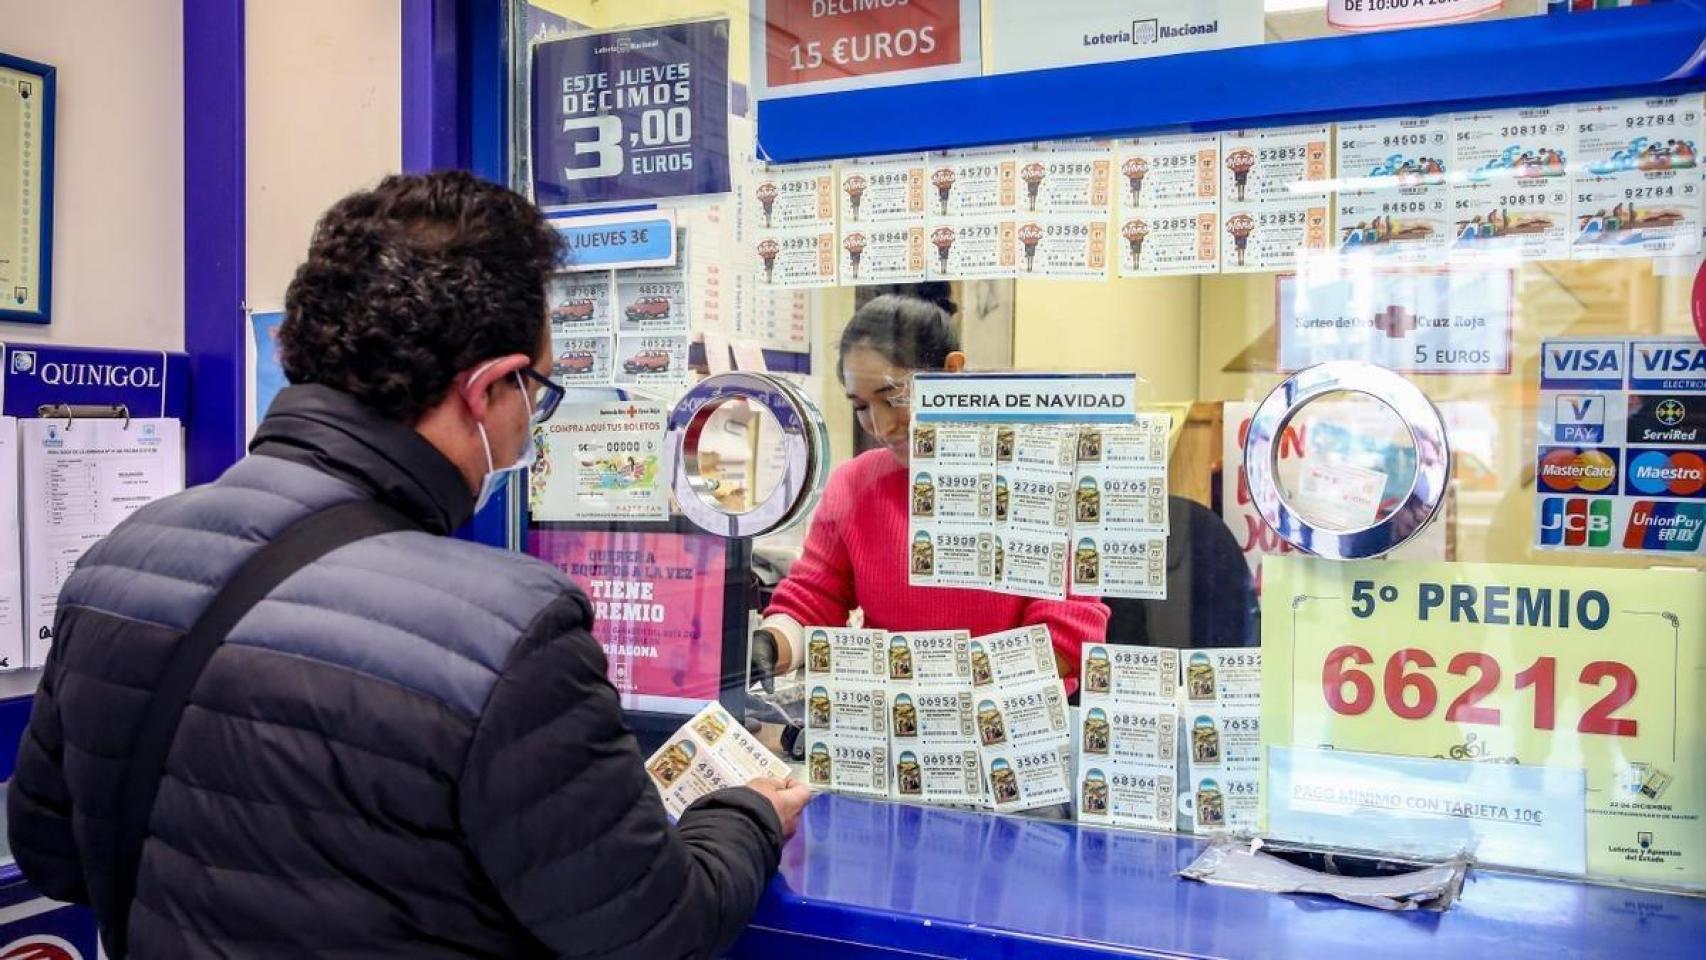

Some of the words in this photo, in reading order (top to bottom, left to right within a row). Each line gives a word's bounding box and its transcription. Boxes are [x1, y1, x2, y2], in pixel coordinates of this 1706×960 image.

[1344, 0, 1362, 11] DE
[1159, 20, 1217, 38] Nacional
[789, 41, 823, 70] 15
[832, 26, 935, 65] €UROS
[563, 73, 608, 93] ESTE
[615, 63, 690, 87] JUEVES
[1626, 113, 1675, 128] 92784
[1501, 124, 1547, 137] 30819
[1153, 154, 1197, 167] 52855
[1260, 147, 1306, 161] 52852
[632, 152, 693, 175] EUROS
[960, 166, 998, 178] 45701
[781, 181, 816, 193] 42913
[1625, 186, 1673, 199] 92784
[1500, 194, 1545, 206] 30819
[1153, 218, 1197, 231] 52855
[1260, 212, 1306, 226] 52852
[575, 230, 627, 249] JUEVES
[631, 228, 648, 244] 3€
[959, 226, 998, 238] 45701
[783, 237, 818, 248] 42913
[1335, 316, 1350, 328] de
[1418, 316, 1449, 328] Cruz
[1454, 316, 1486, 330] Roja
[1415, 345, 1428, 364] 5
[1435, 349, 1491, 364] EUROS
[1552, 349, 1619, 371] VISA
[1638, 349, 1706, 371] VISA
[41, 363, 160, 387] QUINIGOL
[1662, 380, 1706, 389] ELECTRO
[921, 393, 1000, 408] LOTERIA
[1005, 393, 1031, 408] DE
[1036, 393, 1126, 408] NAVIDAD
[550, 424, 583, 433] COMPRA
[606, 423, 621, 432] TUS
[623, 421, 660, 431] BOLETOS
[1564, 428, 1592, 440] PAY
[1643, 429, 1696, 441] ServiRed
[606, 441, 641, 452] 00000
[1543, 464, 1614, 477] MasterCard
[1637, 466, 1701, 480] Maestro
[938, 476, 977, 488] 53909
[1013, 481, 1054, 495] 27280
[1104, 480, 1147, 492] 00765
[1541, 514, 1609, 531] JCB
[1633, 512, 1702, 532] UnionPay
[937, 535, 976, 547] 53909
[1008, 541, 1049, 554] 27280
[1104, 542, 1146, 554] 00765
[647, 552, 655, 563] A
[633, 565, 641, 577] A
[645, 566, 661, 577] LA
[667, 567, 693, 580] VEZ
[591, 580, 654, 600] TIENE
[591, 601, 665, 623] REMIO
[1351, 581, 1399, 618] 5º
[1419, 582, 1610, 631] PREMIO
[835, 635, 870, 645] 13106
[914, 638, 952, 648] 06952
[989, 635, 1029, 652] 35651
[602, 643, 659, 658] RRAGONA
[1115, 653, 1158, 665] 68364
[835, 691, 870, 701] 13106
[1322, 644, 1638, 738] 66212
[919, 696, 957, 707] 06952
[1003, 693, 1042, 711] 35651
[1113, 714, 1157, 727] 68364
[1222, 719, 1259, 730] 7653
[836, 748, 870, 759] 13106
[923, 754, 962, 766] 06952
[698, 763, 728, 788] 494
[1112, 775, 1154, 788] 68364
[1227, 782, 1259, 793] 765
[1405, 795, 1439, 810] CON
[1515, 808, 1543, 823] 10€
[1638, 855, 1664, 863] Estado
[1647, 848, 1682, 857] Apuestas
